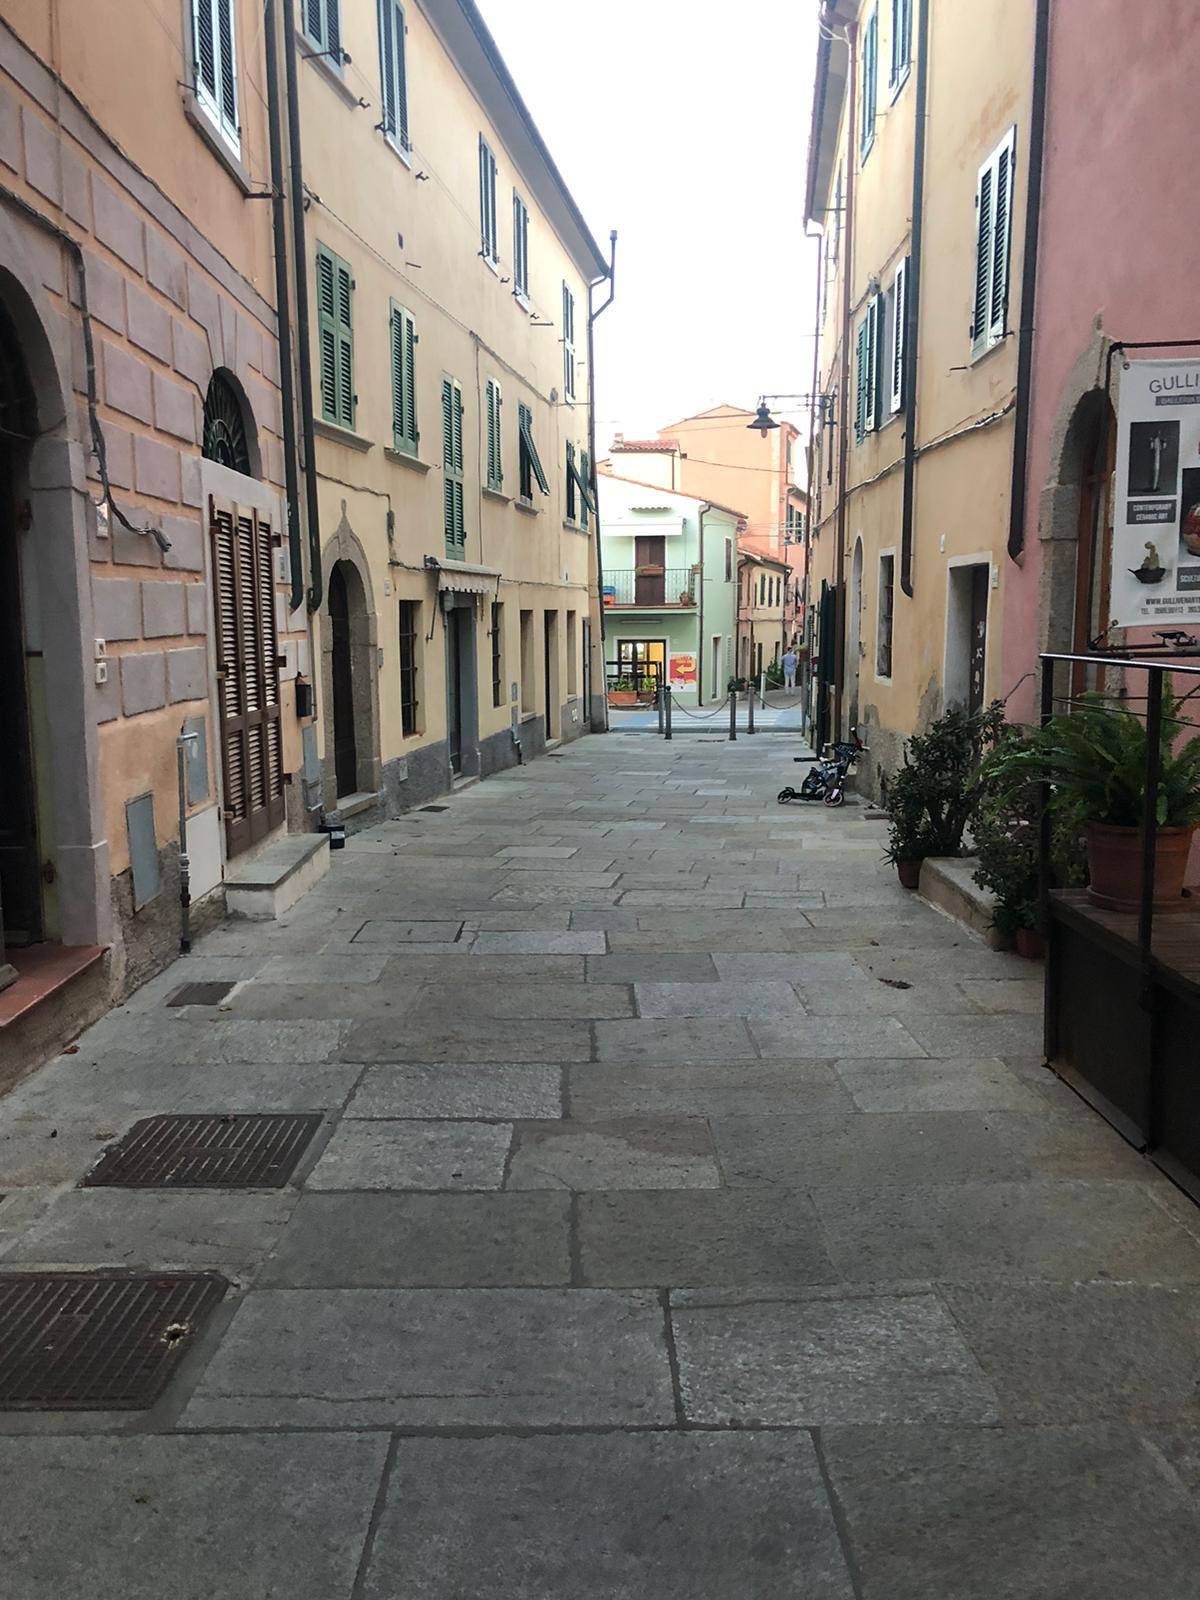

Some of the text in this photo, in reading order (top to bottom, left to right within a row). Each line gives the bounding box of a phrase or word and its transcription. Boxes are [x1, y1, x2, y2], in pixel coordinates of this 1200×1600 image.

[1149, 373, 1199, 393] GULLI
[1133, 503, 1172, 511] CONTEMPORARY
[1158, 512, 1168, 520] ART
